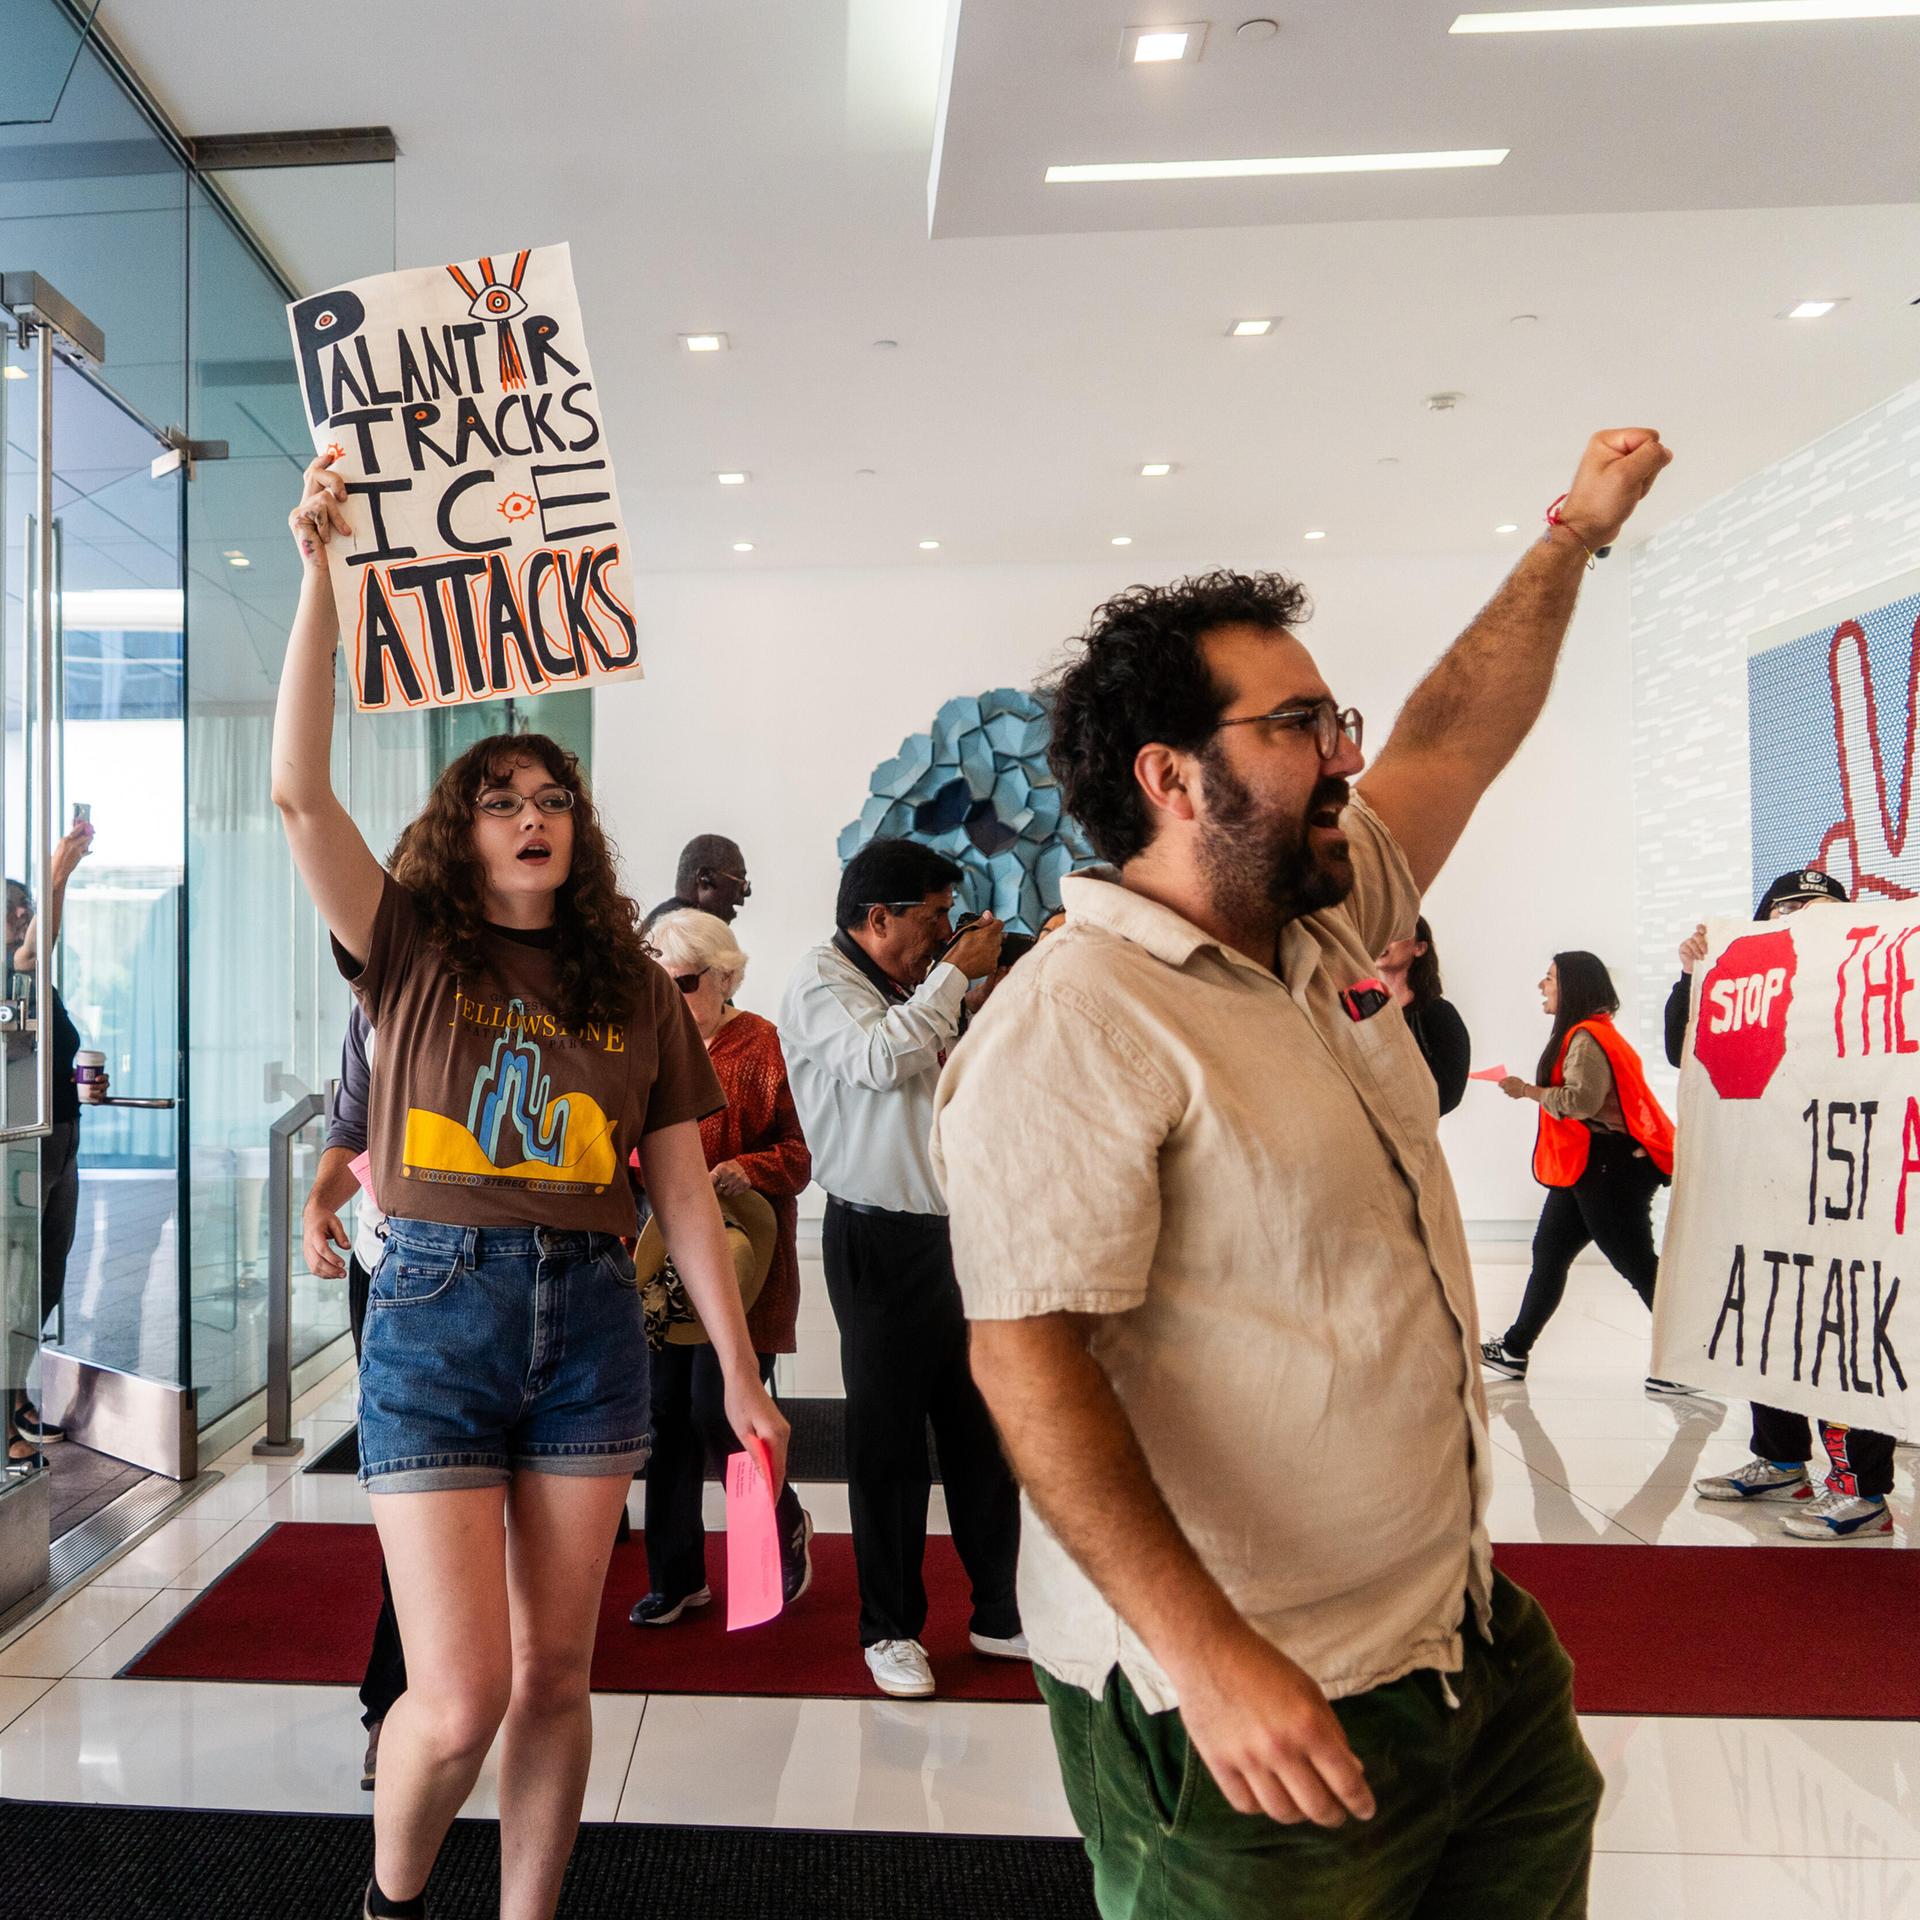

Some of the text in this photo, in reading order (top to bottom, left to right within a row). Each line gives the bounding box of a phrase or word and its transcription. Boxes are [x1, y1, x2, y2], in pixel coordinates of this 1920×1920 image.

[292, 289, 581, 427] PALANTIR
[330, 382, 600, 474] TRACKS
[343, 460, 617, 566] ICE
[360, 544, 639, 706] ATTACKS
[449, 992, 625, 1053] ELLOWSNE
[1710, 924, 1920, 1058] STOP THE
[483, 1177, 528, 1189] STEREO
[1803, 1099, 1879, 1225] 1ST
[1708, 1244, 1908, 1397] ATTACK
